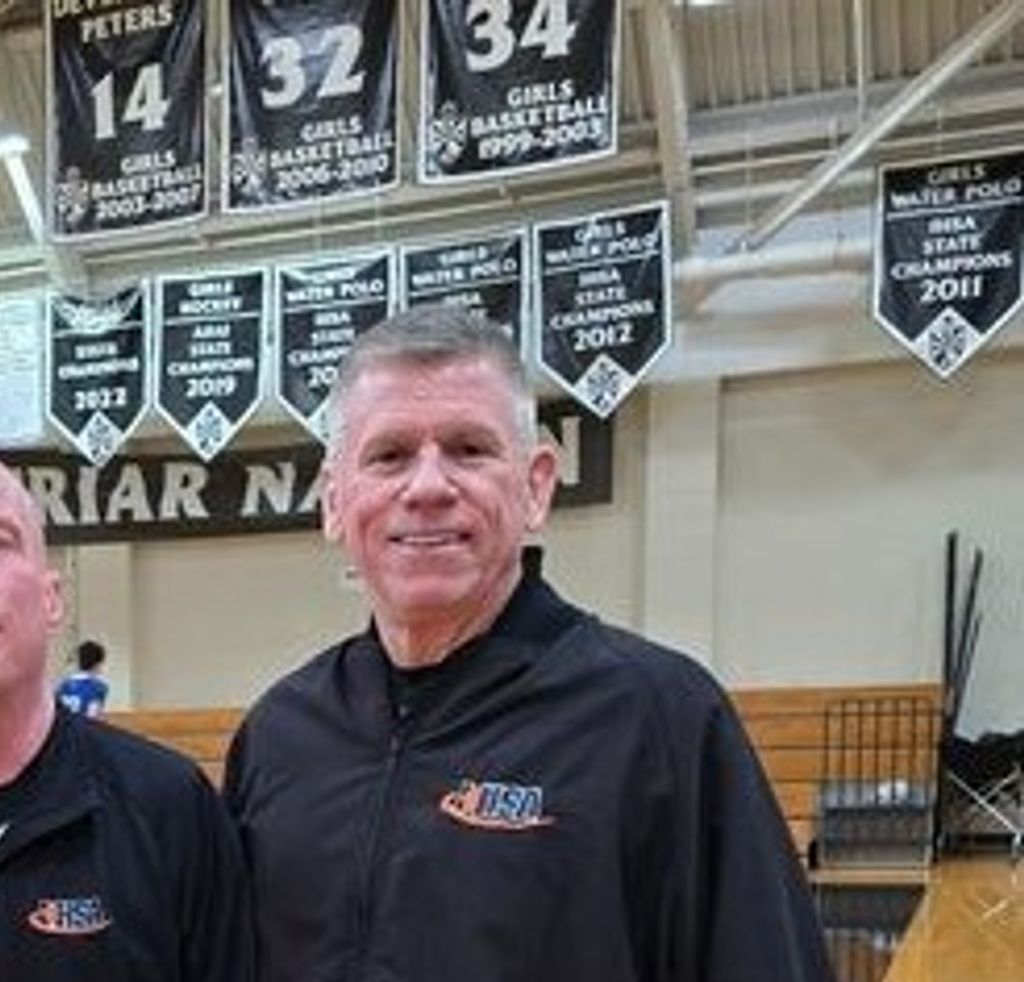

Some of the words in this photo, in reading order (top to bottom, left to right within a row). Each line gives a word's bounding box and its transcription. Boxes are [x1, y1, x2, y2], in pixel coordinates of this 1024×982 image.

[81, 3, 173, 42] PETERS
[466, 0, 578, 72] 34
[260, 24, 367, 110] 32
[90, 62, 172, 140] 14
[507, 79, 575, 106] GIRLS
[300, 116, 363, 142] GIRLS
[470, 95, 608, 137] BASKETBALL
[120, 151, 176, 175] GIRLS
[270, 131, 393, 169] BASKETBALL
[91, 163, 202, 199] BASKETBALL
[966, 178, 1022, 201] POLO
[469, 257, 517, 277] POLO
[890, 252, 1014, 281] CHAMPIONS
[339, 278, 384, 298] POLO
[919, 275, 984, 304] 2011
[548, 299, 656, 330] CHAMPIONS
[574, 322, 634, 351] 2012
[307, 363, 341, 390] 20
[16, 461, 210, 526] RIAR
